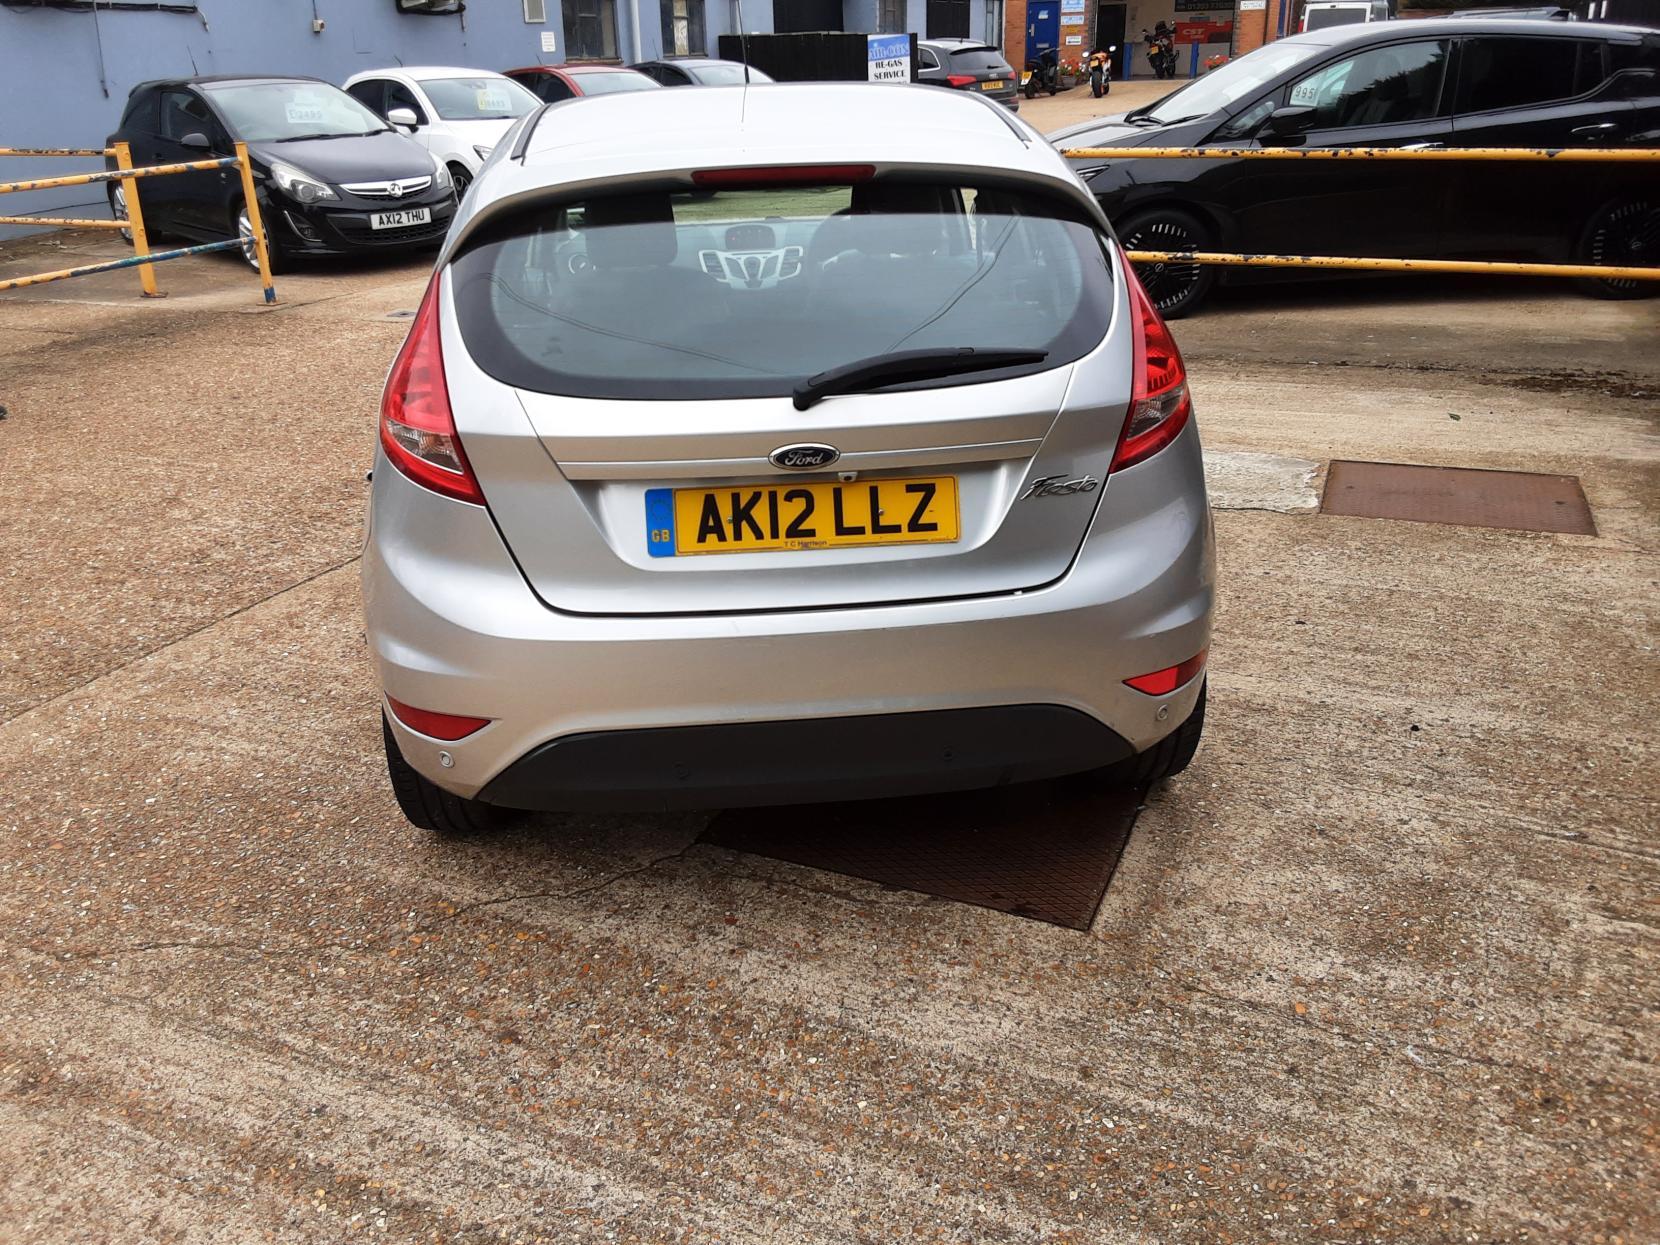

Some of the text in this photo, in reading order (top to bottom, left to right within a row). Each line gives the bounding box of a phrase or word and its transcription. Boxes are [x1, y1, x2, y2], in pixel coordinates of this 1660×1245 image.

[875, 59, 903, 69] RE-GAS
[873, 70, 904, 80] SERVICE
[378, 209, 425, 226] AX12 THU
[784, 449, 824, 466] Ford
[696, 483, 939, 545] AK12 LLZ
[651, 529, 670, 543] GB
